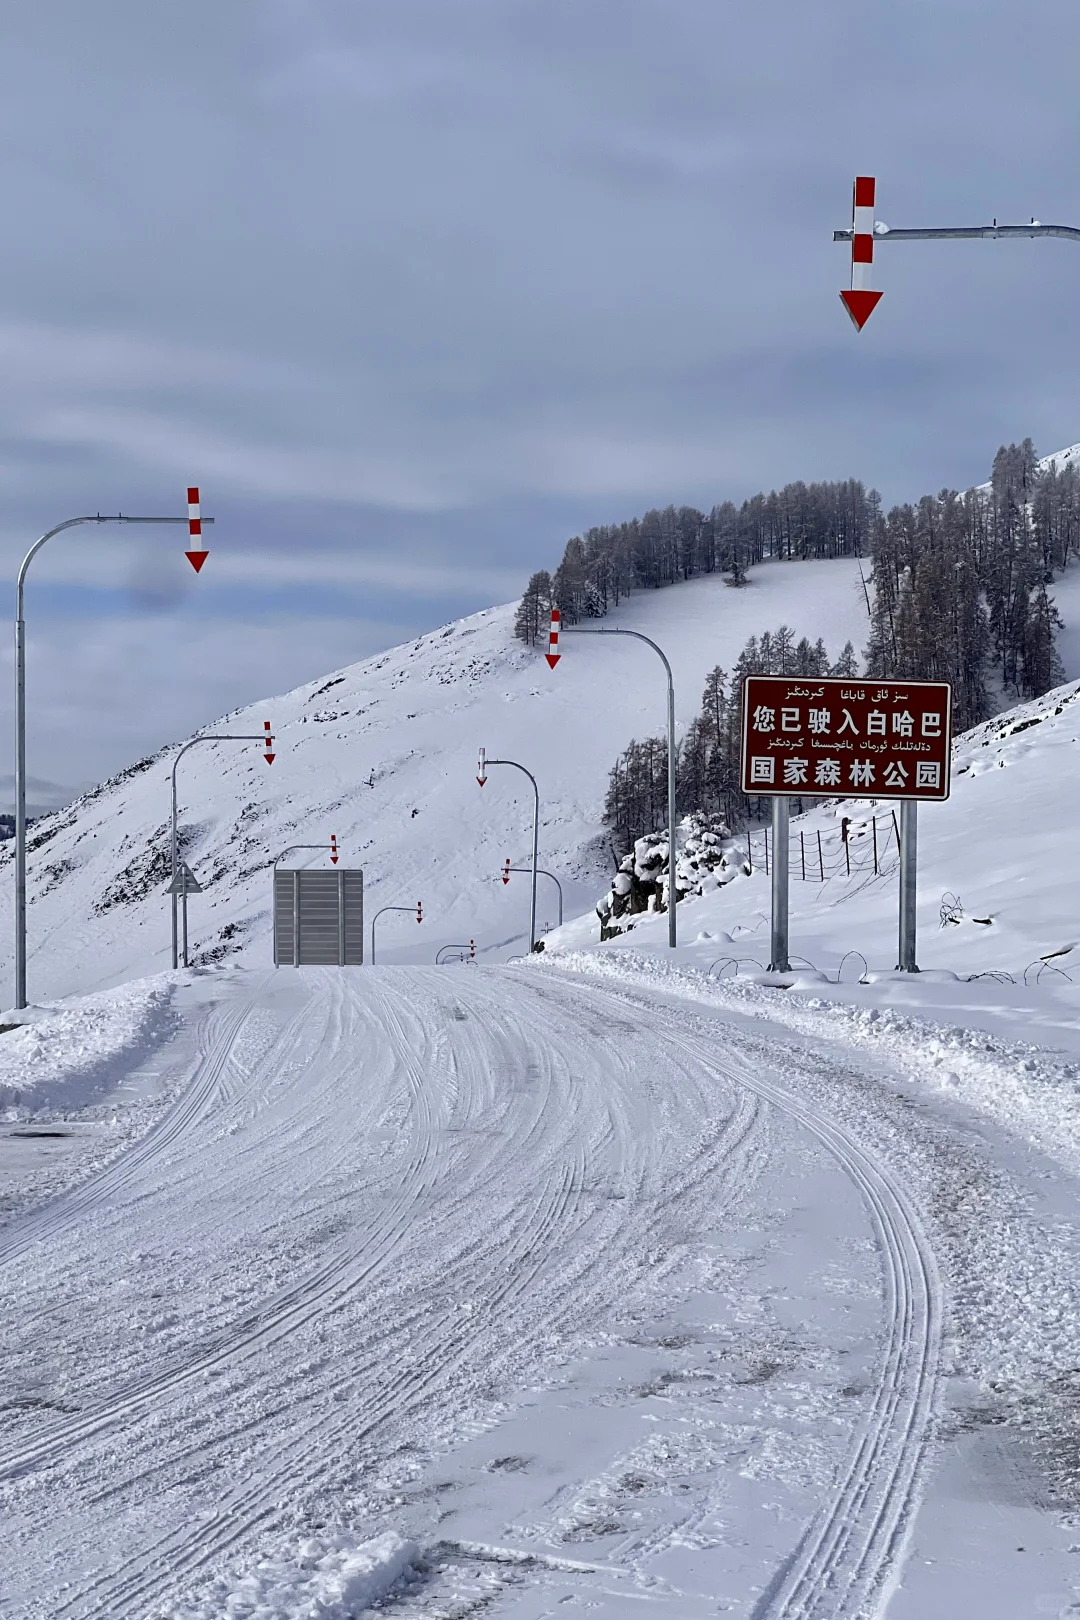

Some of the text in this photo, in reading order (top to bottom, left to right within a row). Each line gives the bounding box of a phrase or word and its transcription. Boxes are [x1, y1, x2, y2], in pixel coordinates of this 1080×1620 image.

[752, 705, 942, 738] 您已驶入白哈巴
[750, 755, 941, 789] 国家森林公园
